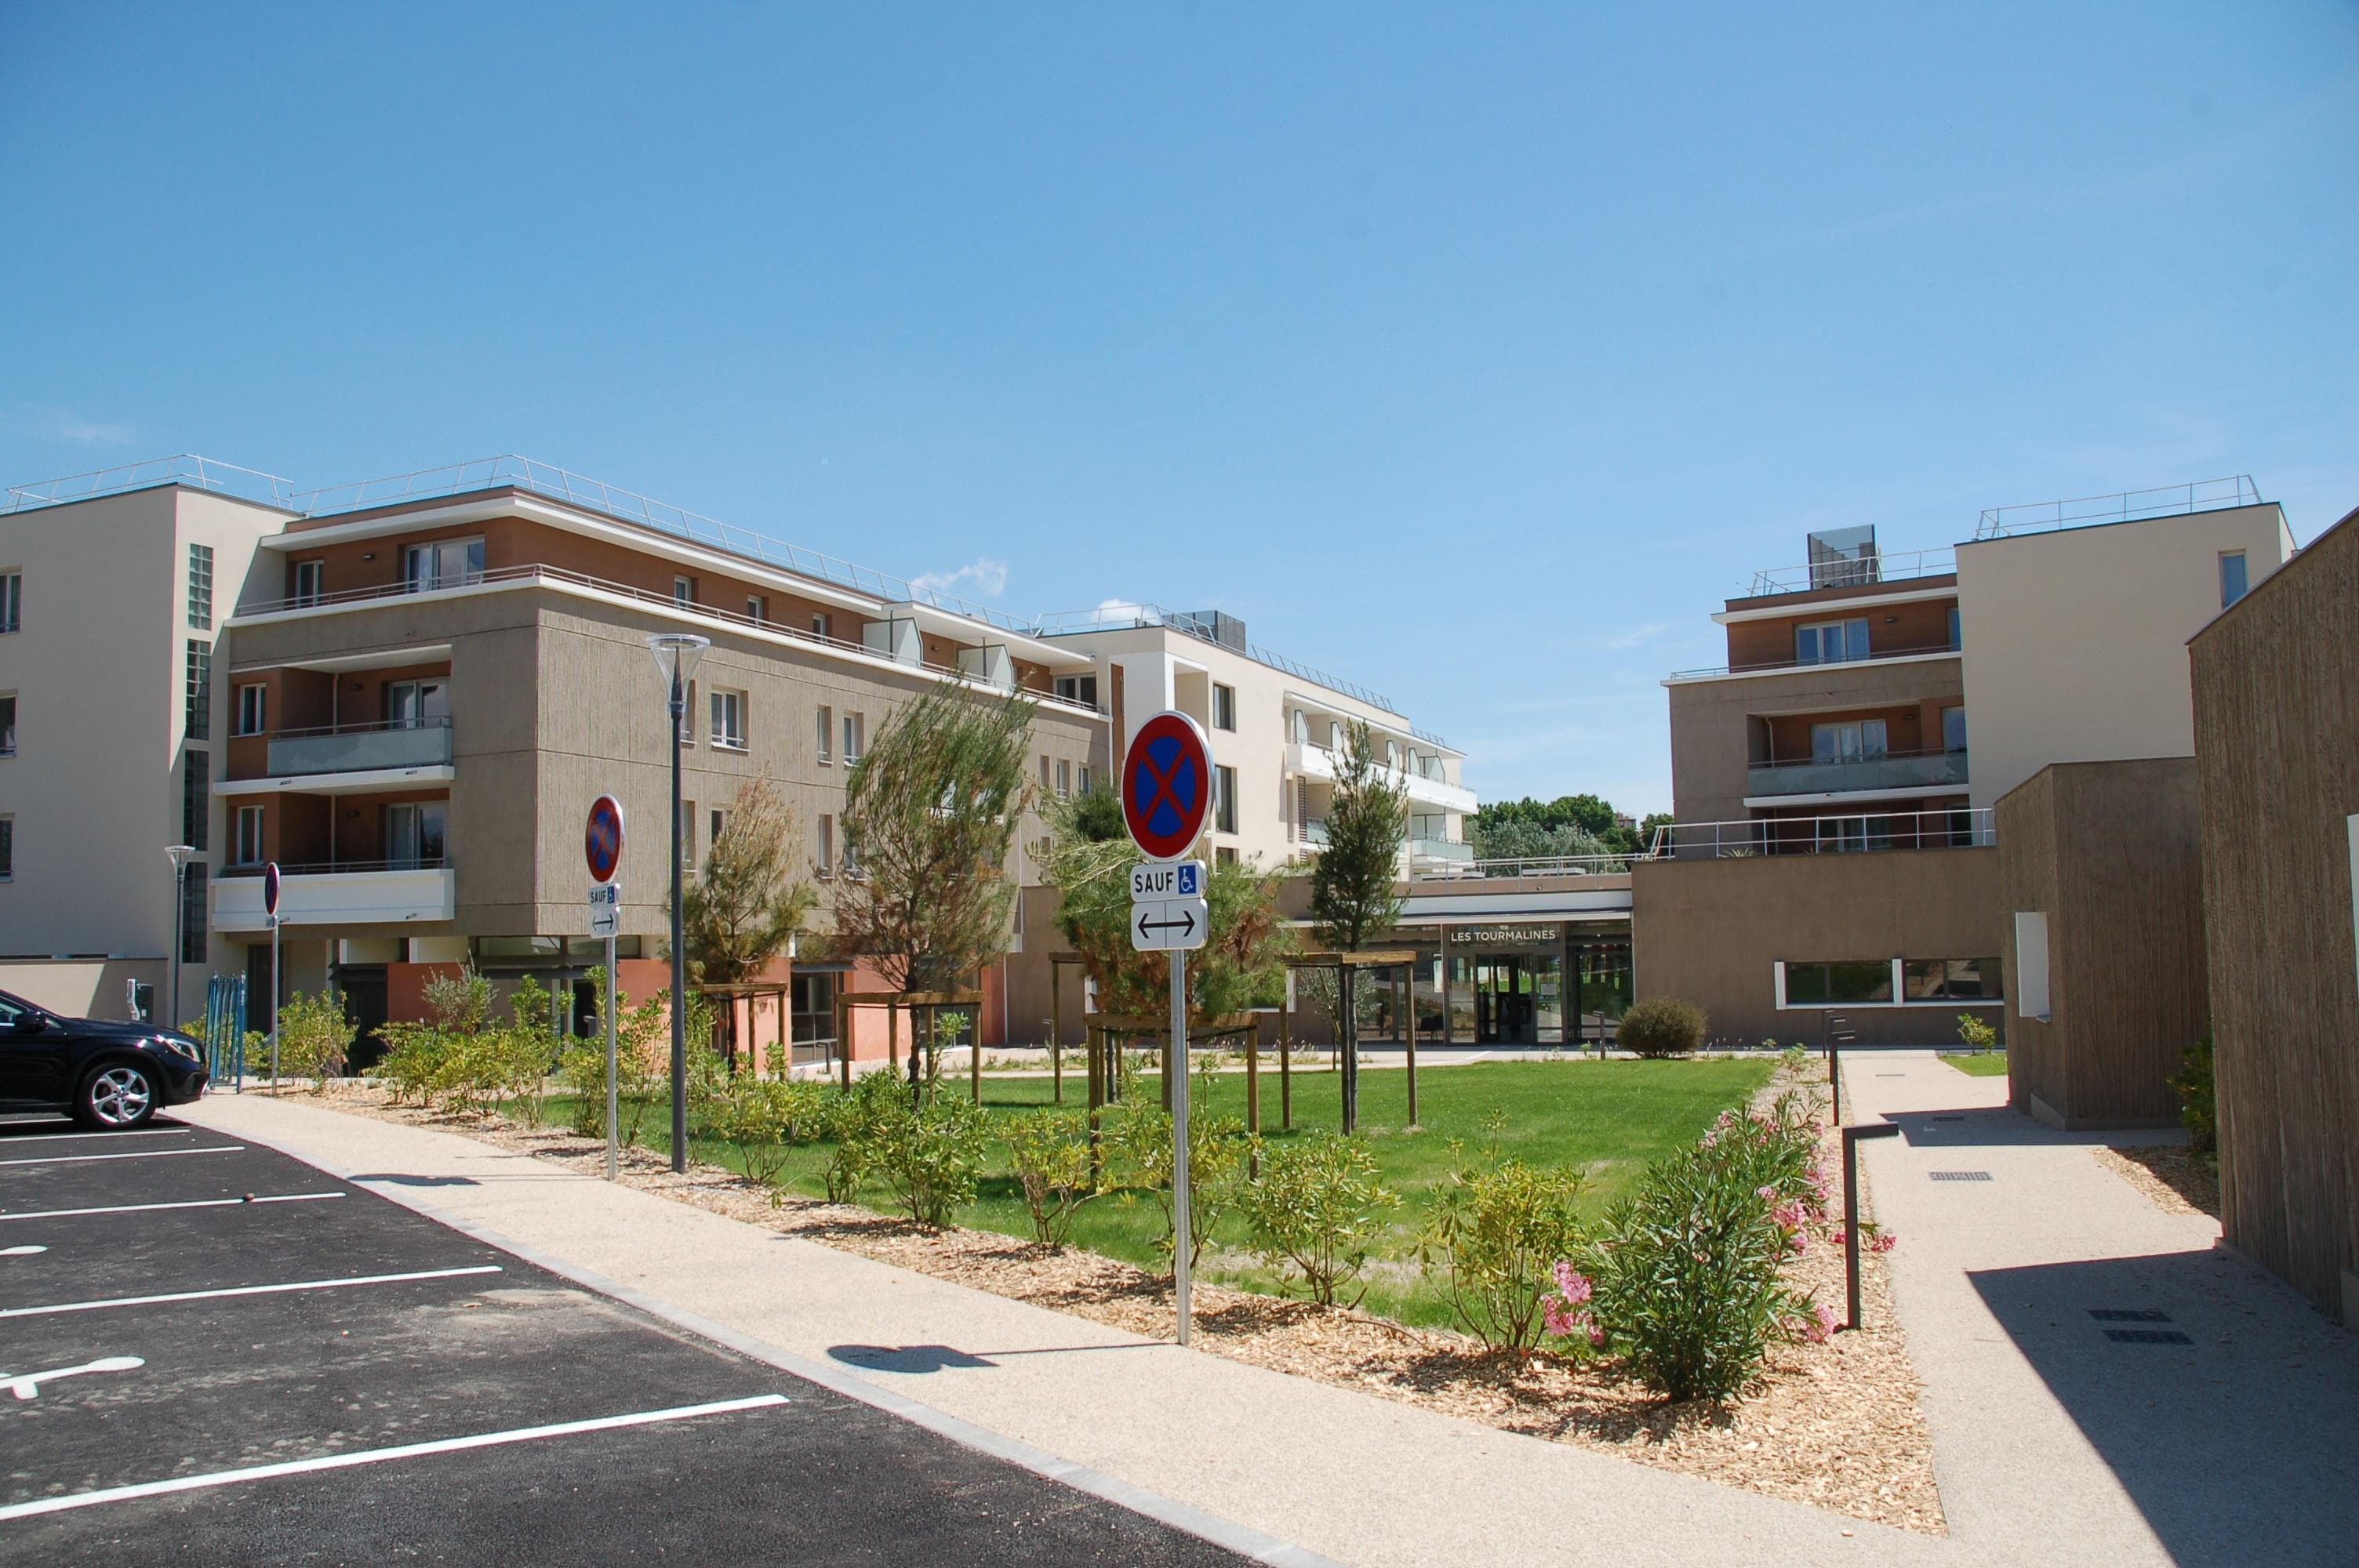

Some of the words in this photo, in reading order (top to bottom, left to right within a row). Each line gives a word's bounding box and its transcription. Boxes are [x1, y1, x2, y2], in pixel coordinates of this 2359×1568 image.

[1135, 872, 1173, 893] SAUF
[591, 891, 606, 903] SAUF
[1452, 932, 1470, 941] LES
[1474, 930, 1556, 941] TOURMALINES
